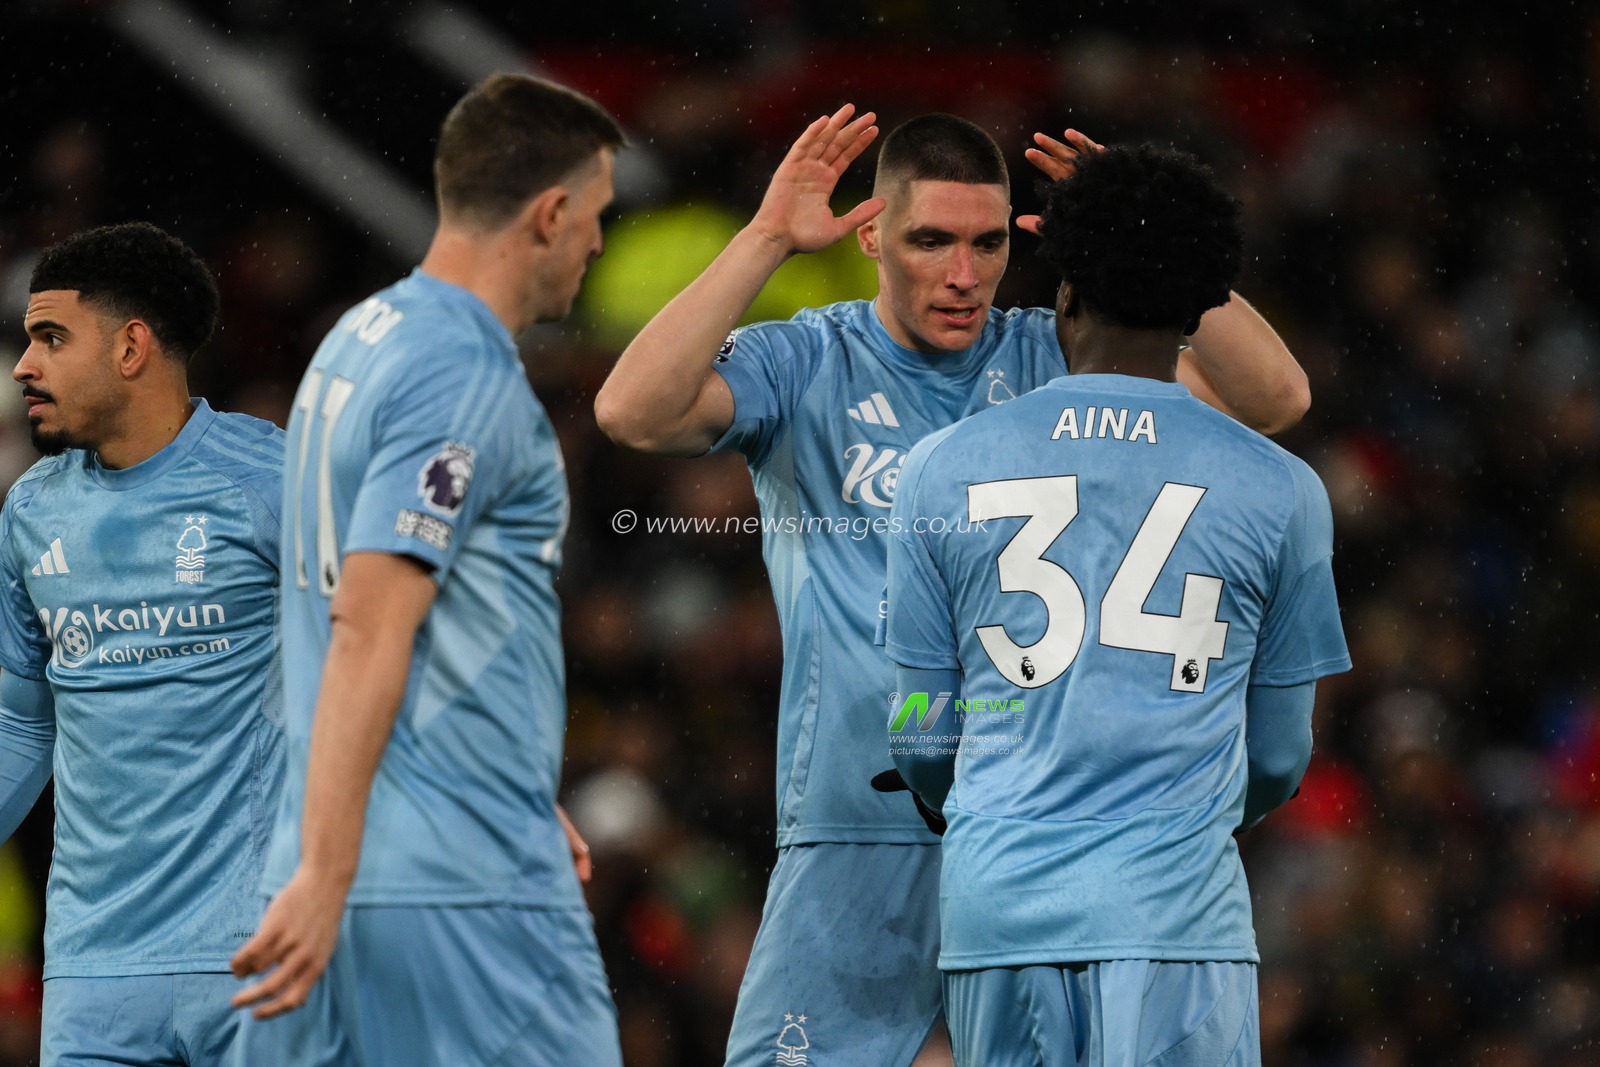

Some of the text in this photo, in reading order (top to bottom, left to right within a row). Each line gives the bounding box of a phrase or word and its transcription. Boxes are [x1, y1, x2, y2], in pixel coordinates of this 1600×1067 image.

[1050, 406, 1158, 444] AINA
[175, 570, 205, 584] FOREST
[967, 474, 1230, 694] 34
[93, 601, 226, 637] kaiyun
[98, 637, 230, 665] kaiyun.com
